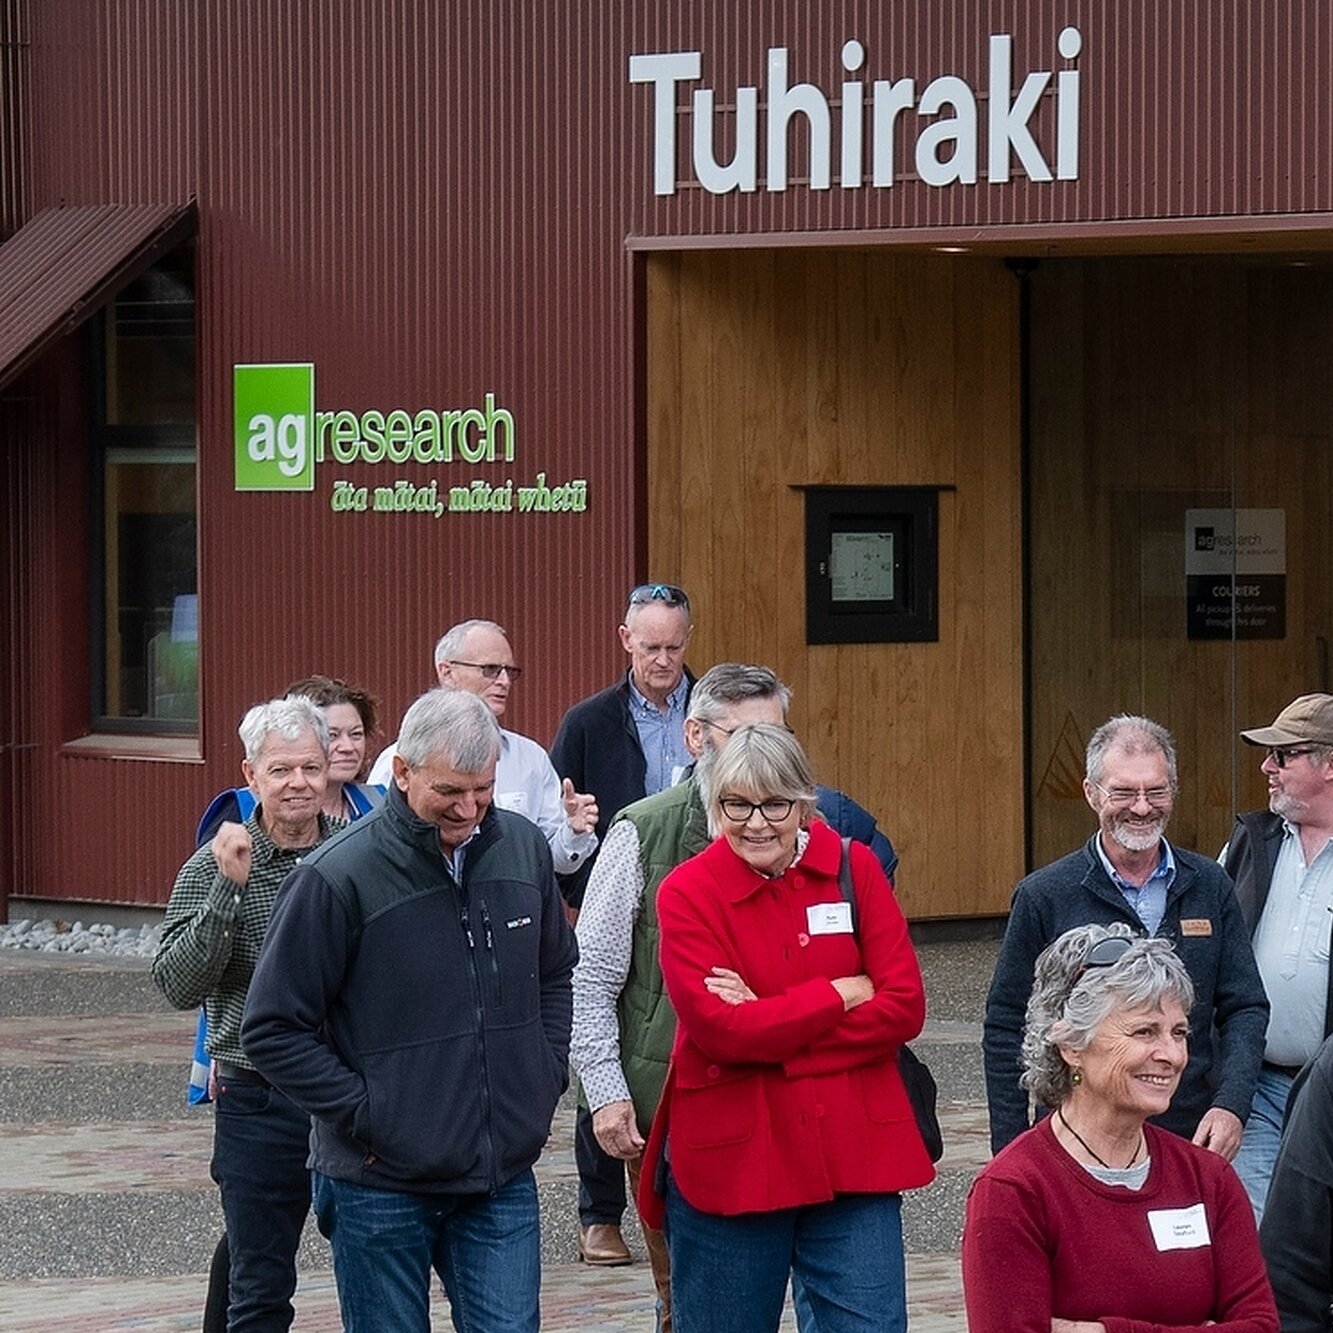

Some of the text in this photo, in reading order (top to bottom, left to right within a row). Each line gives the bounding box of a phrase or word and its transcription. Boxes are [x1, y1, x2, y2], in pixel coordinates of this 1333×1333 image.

[629, 26, 1083, 196] Tuhiraki
[247, 393, 515, 477] agresearch
[449, 479, 513, 512] mātai
[1198, 533, 1262, 549] agresarch
